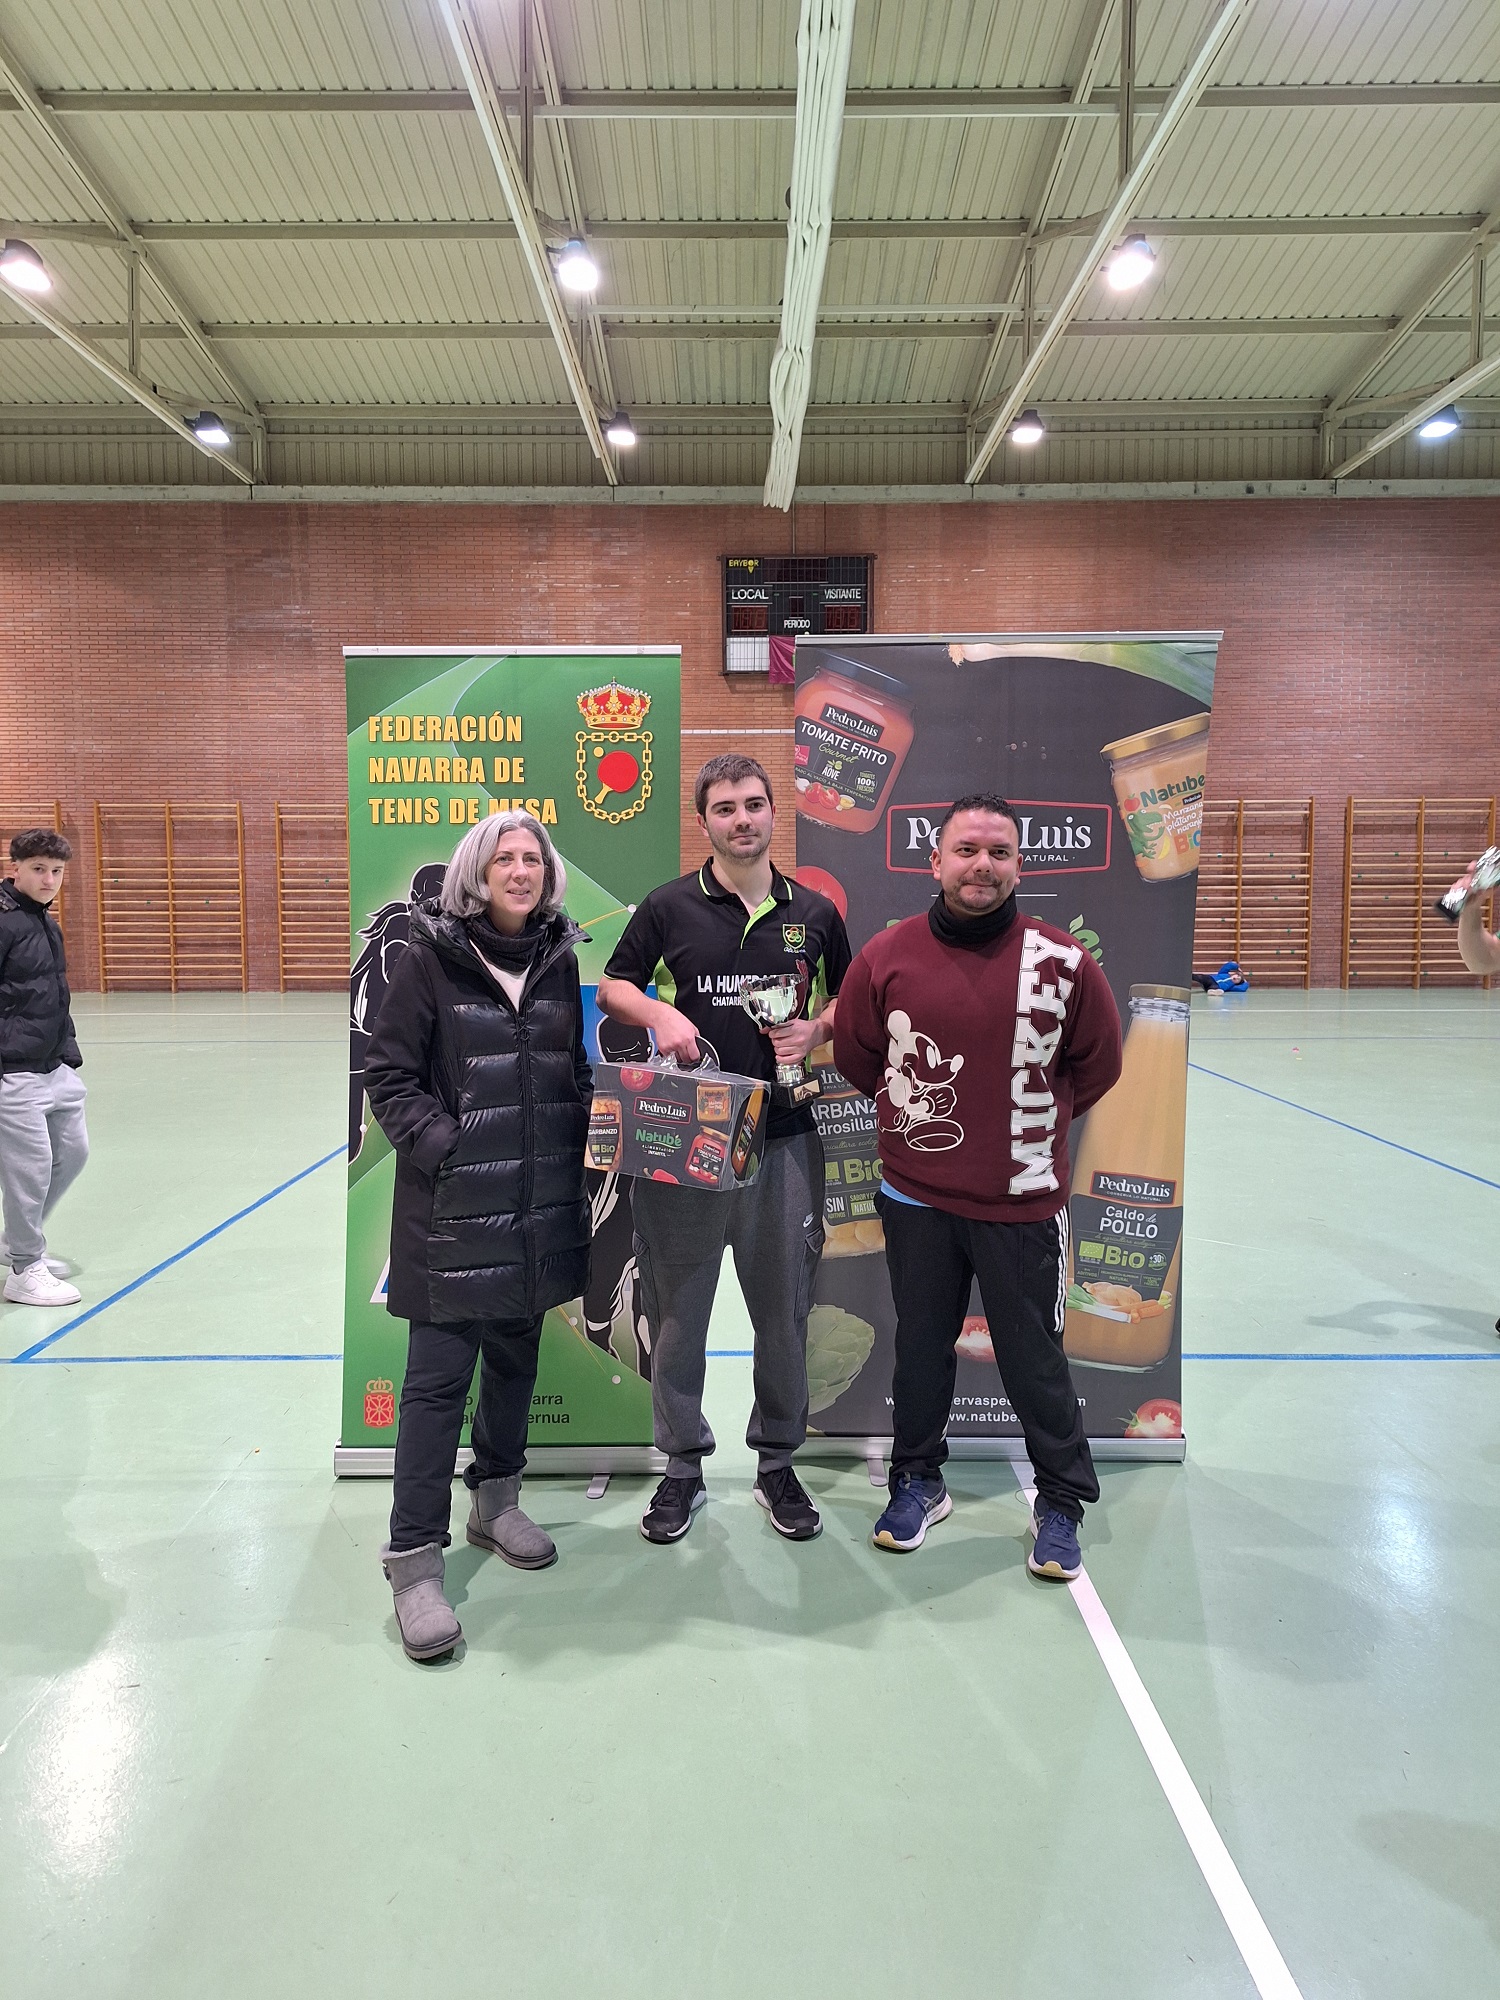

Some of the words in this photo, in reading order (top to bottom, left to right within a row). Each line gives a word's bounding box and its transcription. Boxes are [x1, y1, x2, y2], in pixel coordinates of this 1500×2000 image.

[732, 588, 769, 600] LOCAL
[824, 588, 862, 600] VISITANTE
[784, 620, 810, 628] PERIODO
[368, 711, 522, 742] FEDERACIÓN
[825, 706, 856, 728] Pedro
[856, 720, 879, 737] Luis
[801, 720, 850, 750] TOMATE
[850, 742, 888, 766] FRITO
[818, 742, 860, 764] Gourmet
[368, 756, 486, 784] NAVARRA
[494, 757, 526, 783] DE
[857, 777, 876, 787] 100%
[368, 798, 440, 824] TENIS
[449, 798, 480, 824] DE
[1019, 816, 1092, 850] Luis
[1024, 854, 1069, 862] ATURAL
[697, 975, 712, 992] LA
[1008, 928, 1083, 1195] MICKEY
[638, 1100, 667, 1114] Pedro
[667, 1104, 686, 1118] Luis
[817, 1118, 877, 1136] drosilla
[636, 1128, 682, 1147] Natubé
[1098, 1175, 1142, 1194] Pedro
[1142, 1182, 1170, 1198] Luis
[826, 1196, 845, 1213] SIN
[1106, 1206, 1145, 1222] Caldo
[1145, 1213, 1157, 1224] de
[1100, 1217, 1158, 1239] POLLO
[1104, 1245, 1146, 1269] BiO
[532, 1394, 564, 1406] arra
[527, 1413, 570, 1424] ernua
